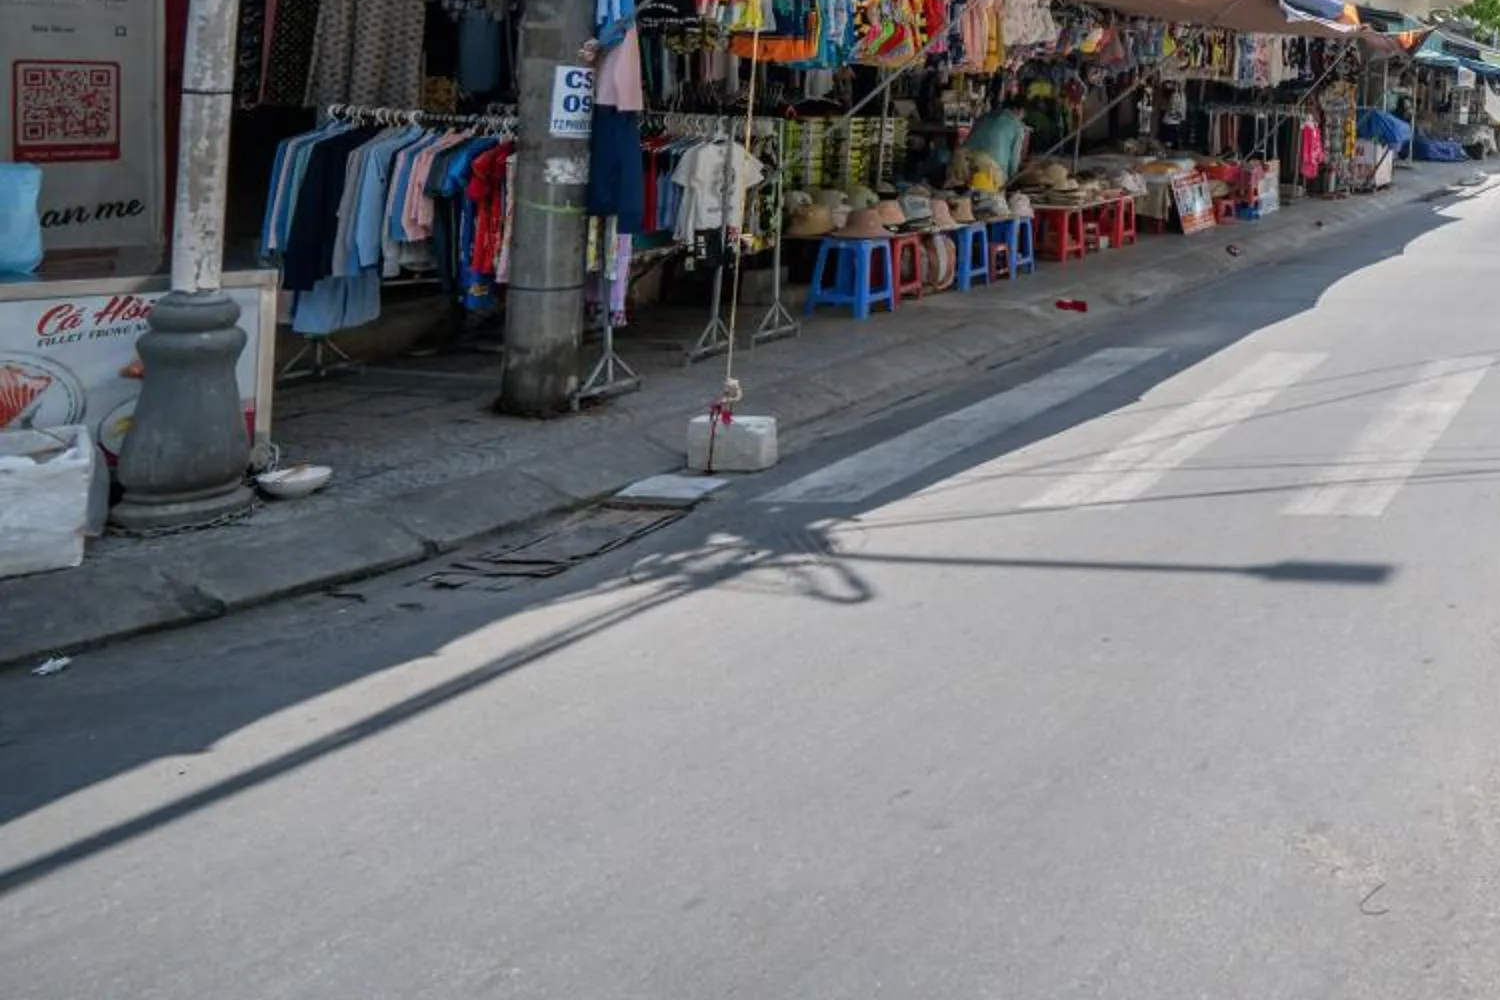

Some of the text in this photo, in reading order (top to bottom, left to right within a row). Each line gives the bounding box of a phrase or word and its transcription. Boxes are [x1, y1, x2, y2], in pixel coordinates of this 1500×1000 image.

[40, 199, 145, 229] an me
[36, 303, 86, 337] Cá
